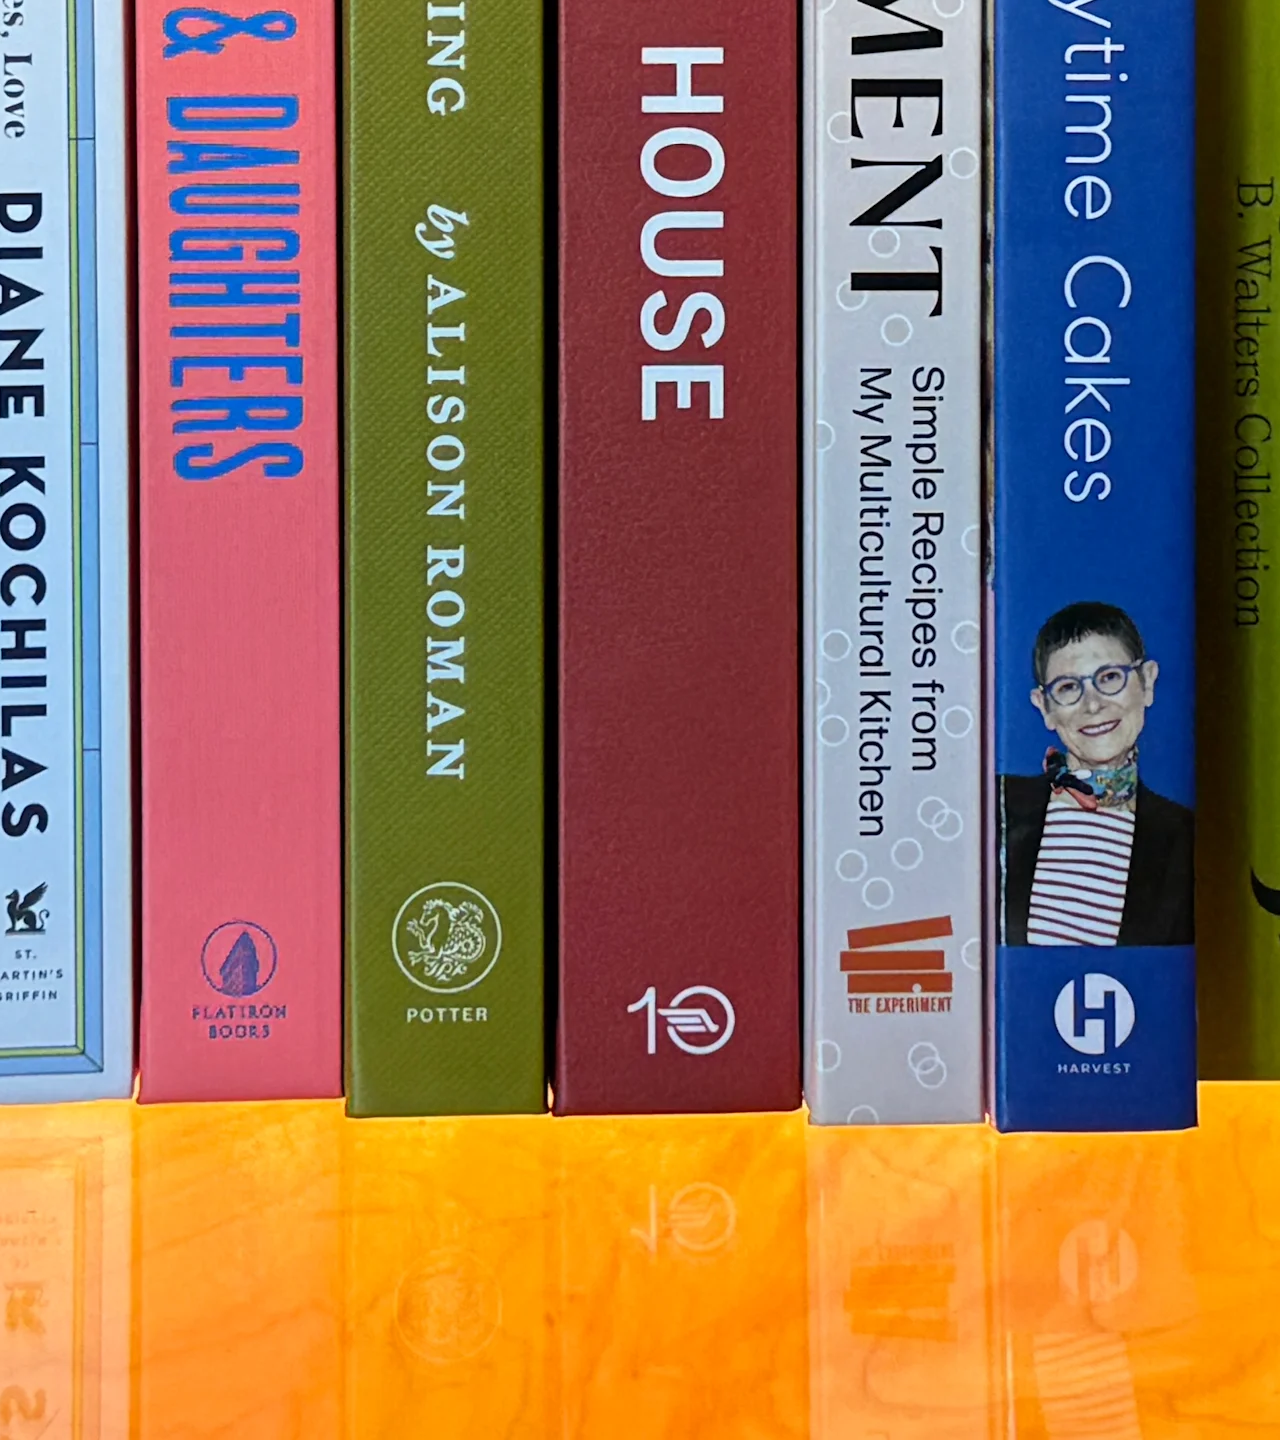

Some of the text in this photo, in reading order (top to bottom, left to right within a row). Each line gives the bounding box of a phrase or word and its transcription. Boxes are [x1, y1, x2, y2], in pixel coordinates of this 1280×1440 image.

[162, 7, 297, 59] &
[2, 54, 32, 139] Love
[640, 46, 725, 421] HOUSE
[165, 94, 304, 482] DAUGHTERS
[1062, 254, 1131, 504] Cakes
[1232, 177, 1273, 629] B. Walters Collection
[416, 202, 469, 780] by ALISON ROMAN
[852, 366, 892, 838] My Multicultural Kitchen
[906, 366, 945, 772] Simple Recipes from
[15, 949, 37, 960] ST.
[192, 1005, 287, 1020] FLATIRON
[208, 1024, 270, 1039] BOOKS
[406, 1007, 489, 1024] POTTER
[848, 996, 952, 1013] THE EXPERIMENT
[1057, 1063, 1131, 1073] HARVEST
